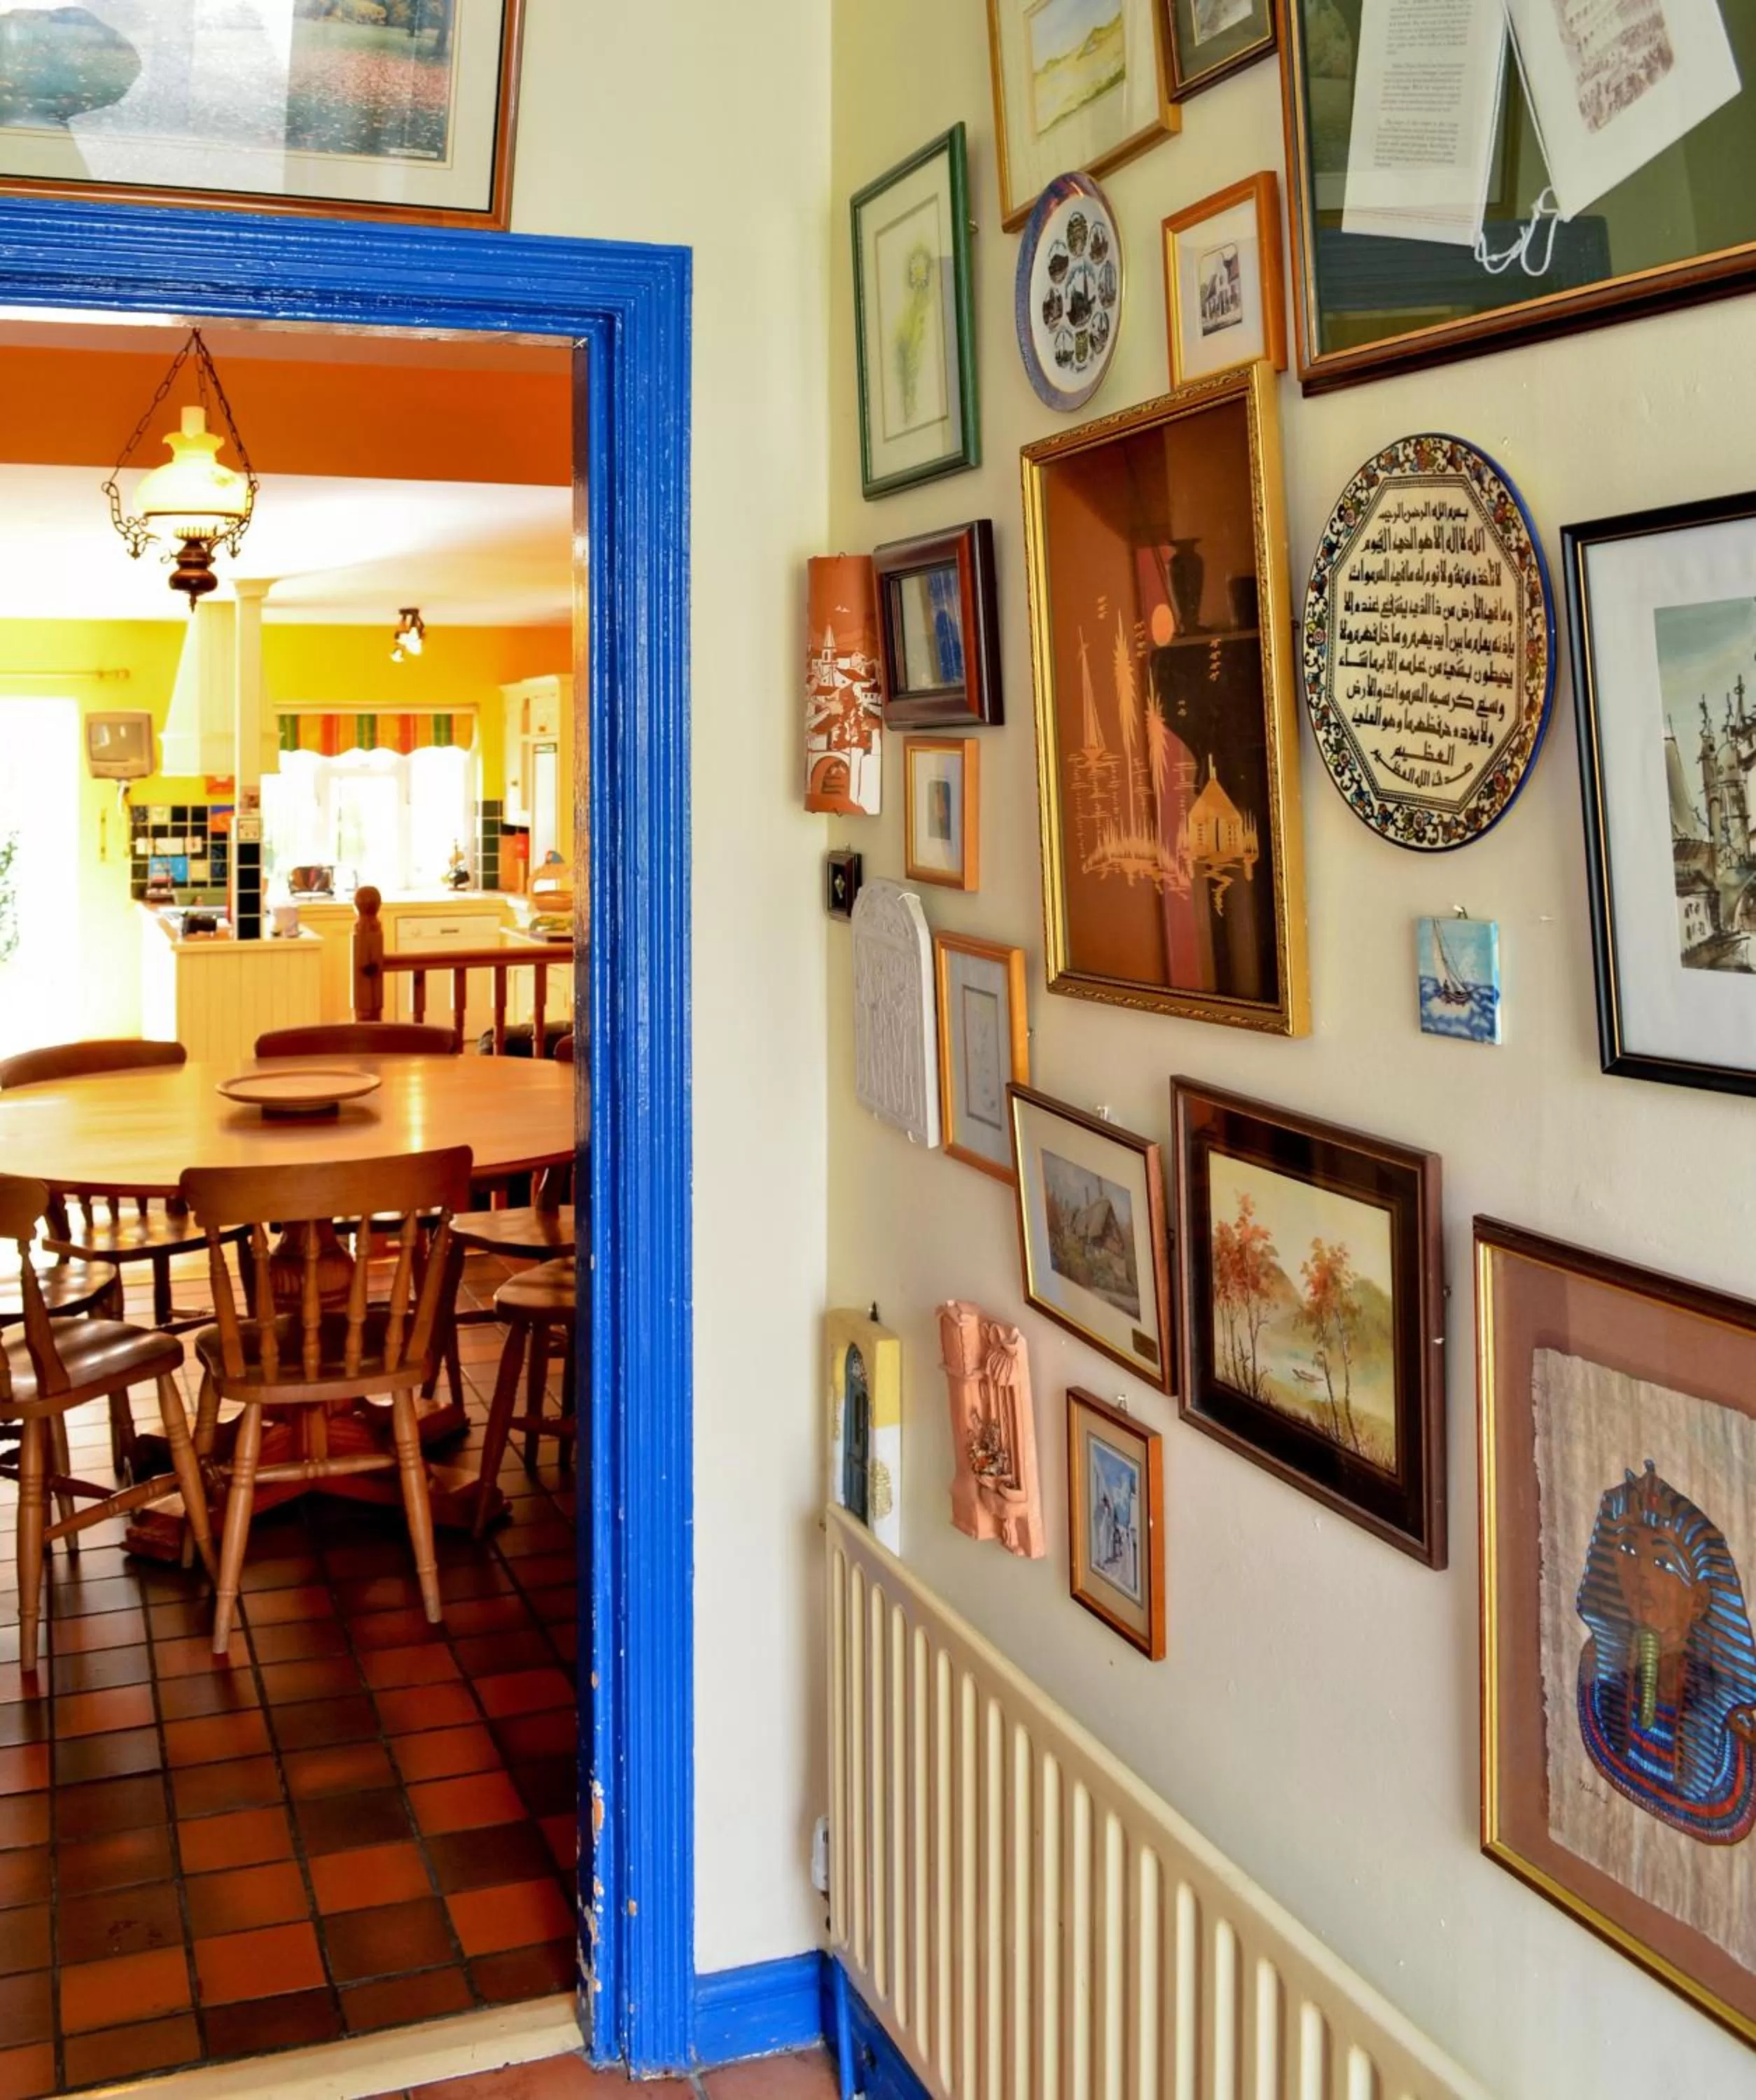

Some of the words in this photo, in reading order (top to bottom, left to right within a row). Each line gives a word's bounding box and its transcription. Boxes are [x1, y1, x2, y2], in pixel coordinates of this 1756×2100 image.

[1433, 501, 1447, 520] الله
[1418, 531, 1433, 554] هو
[1443, 605, 1456, 620] من
[1429, 662, 1442, 678] من
[1390, 740, 1455, 766] العظيم
[1414, 769, 1430, 788] الله
